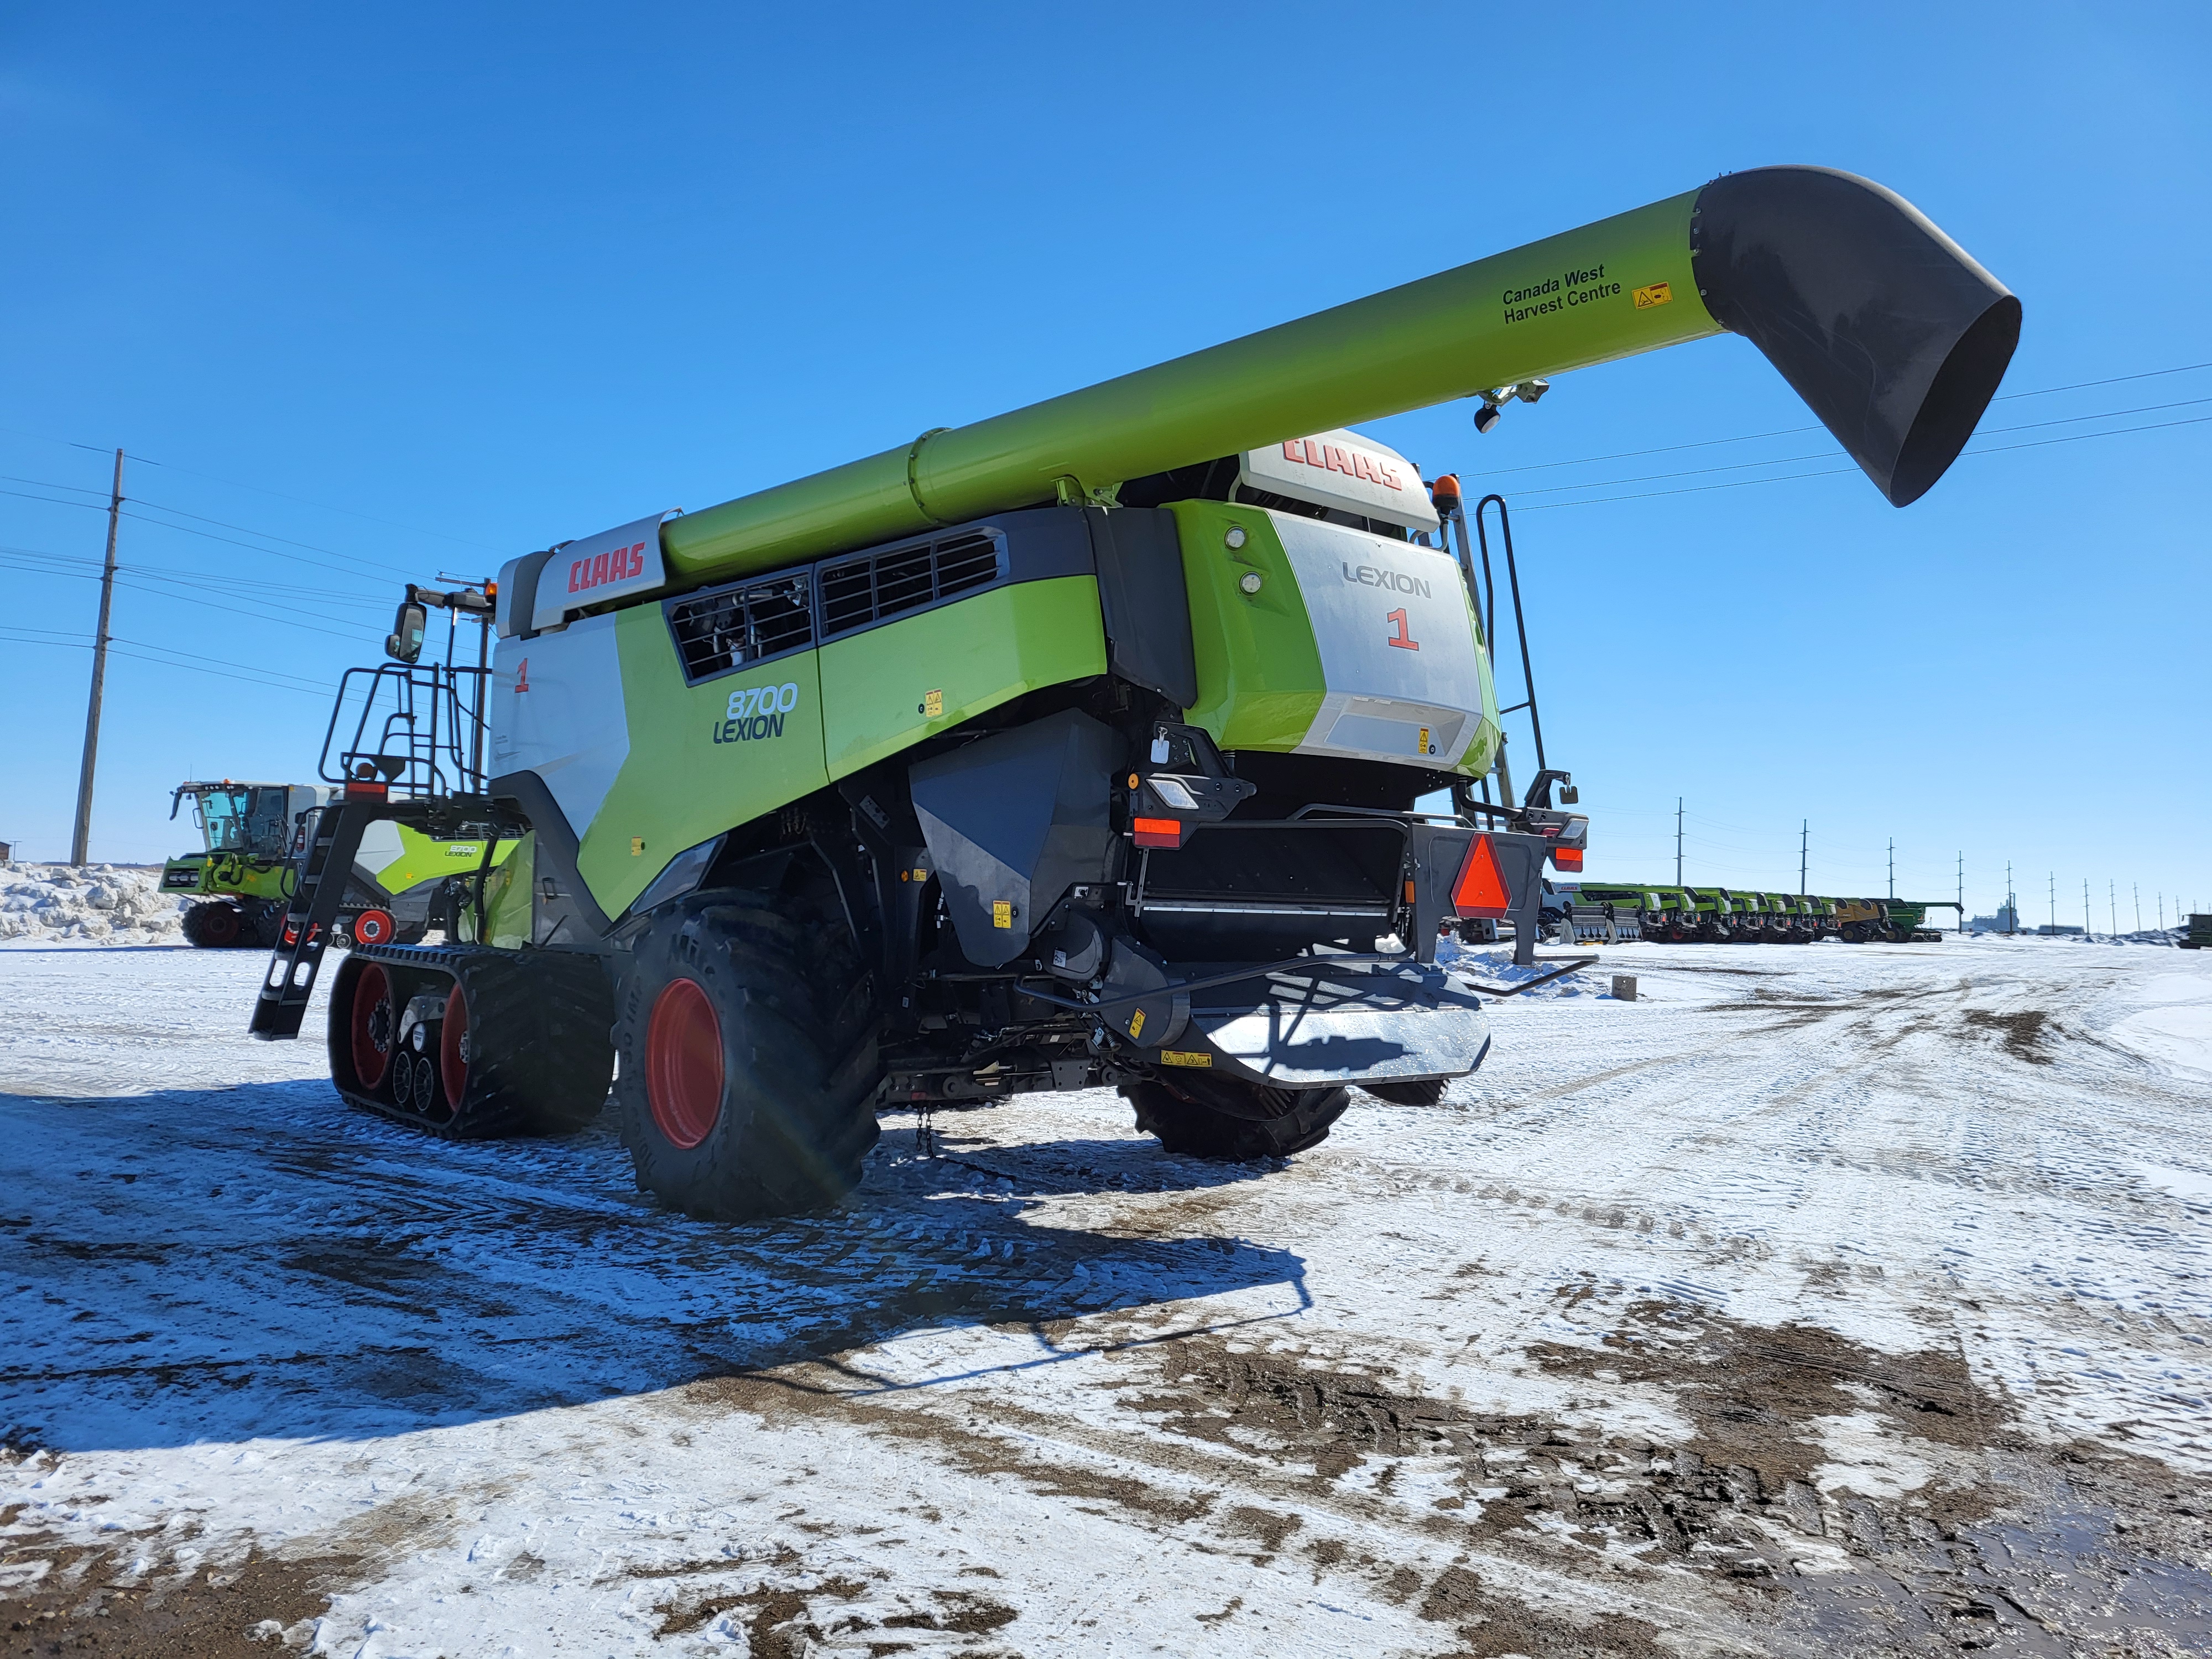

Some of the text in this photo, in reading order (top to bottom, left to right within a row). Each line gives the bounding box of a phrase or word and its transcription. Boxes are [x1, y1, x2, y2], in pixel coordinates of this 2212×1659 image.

[1503, 263, 1605, 305] Canada West
[1504, 282, 1621, 325] Harvest Centre
[1284, 437, 1402, 491] CLAAS
[567, 541, 645, 593] CLAAS
[1342, 561, 1432, 599] LEXION
[1386, 607, 1419, 651] 1
[514, 658, 529, 693] 1
[726, 682, 798, 719] 8700
[713, 713, 785, 744] LEXION
[450, 845, 477, 853] 8700
